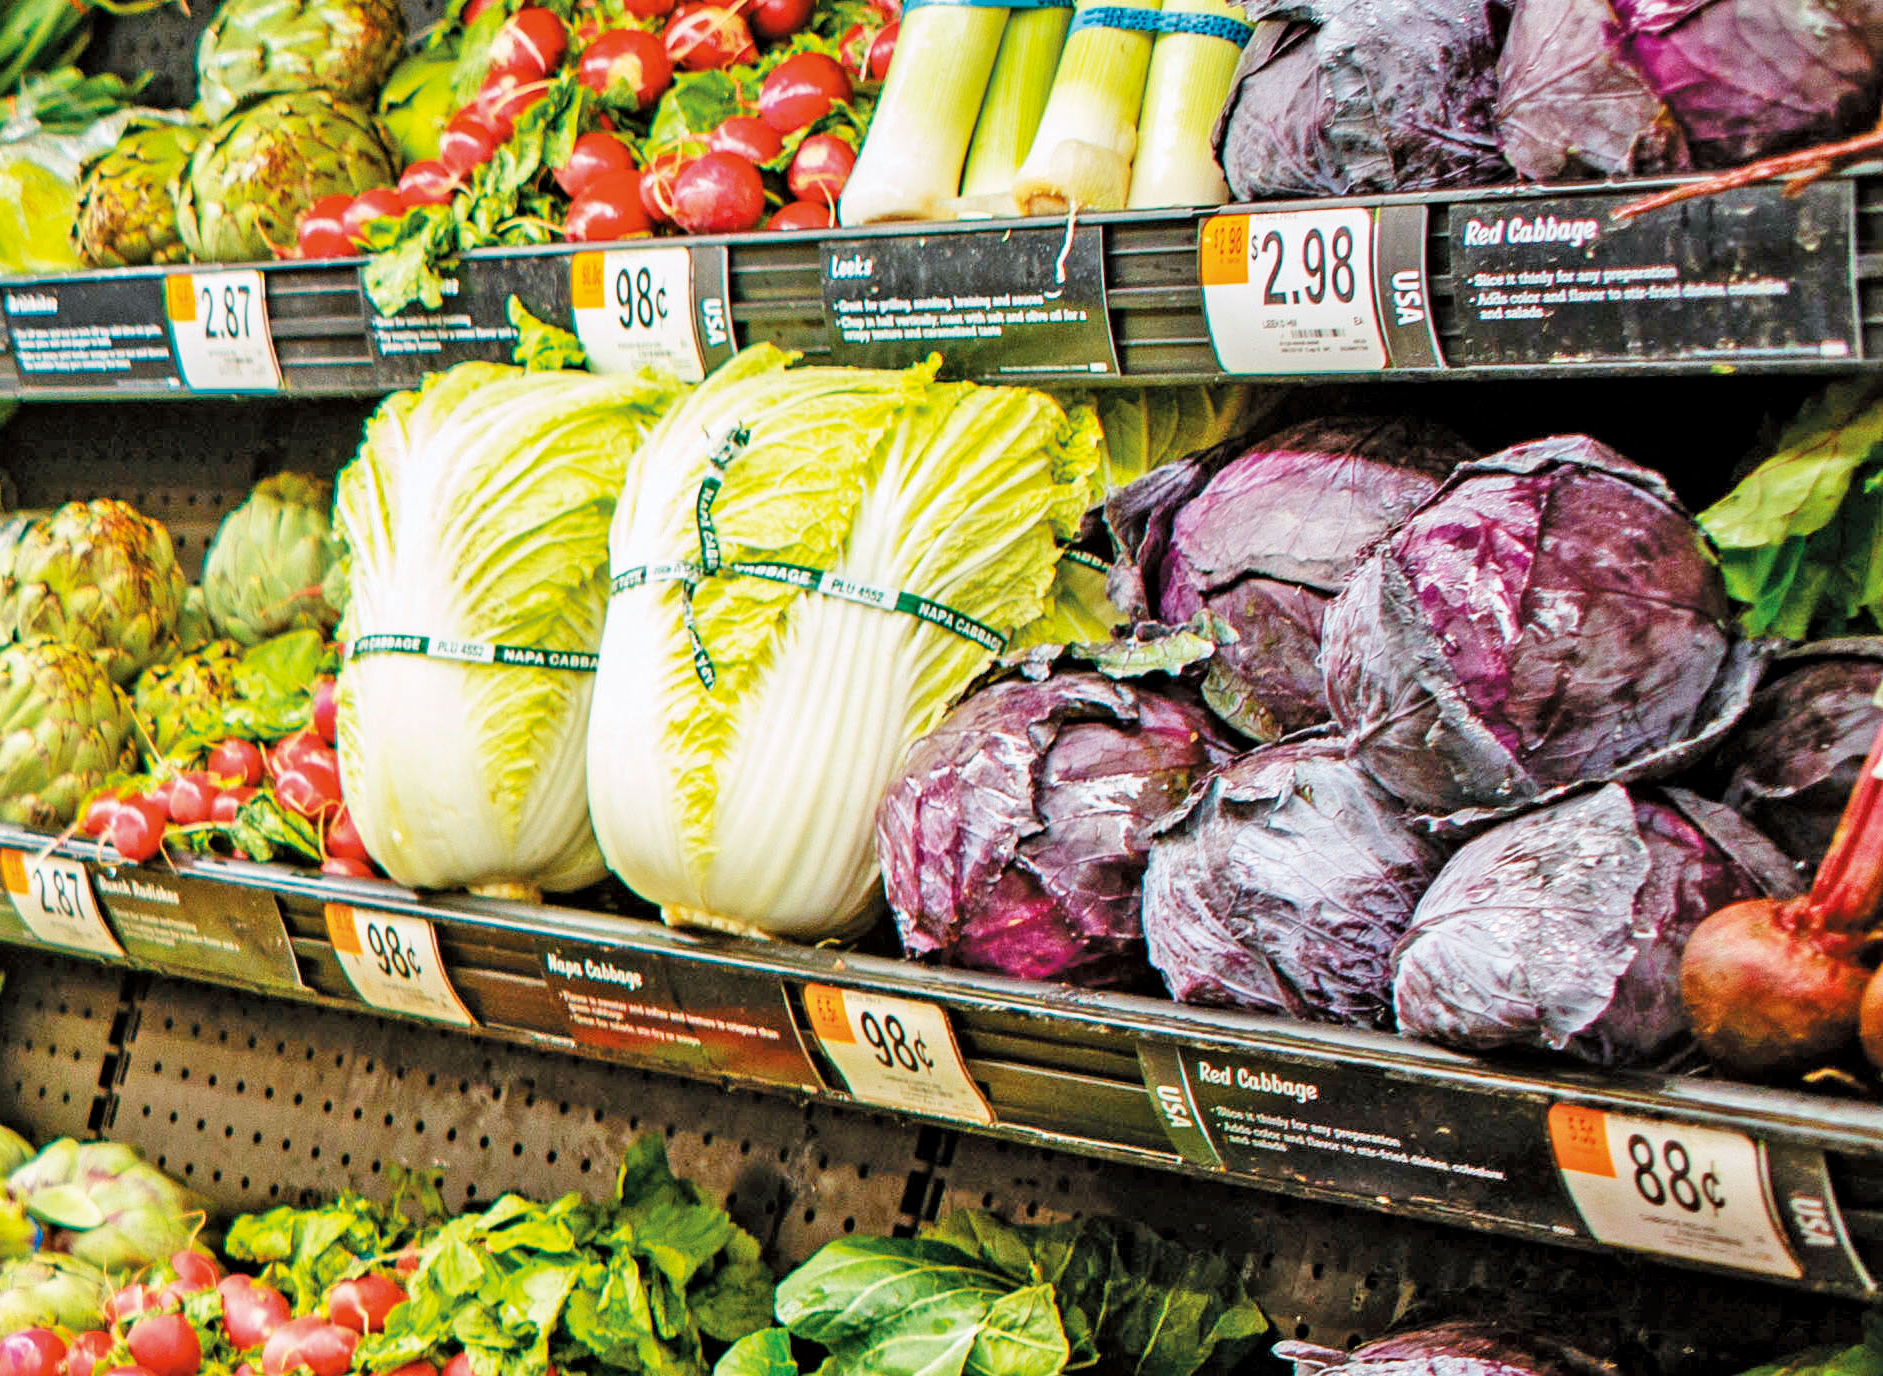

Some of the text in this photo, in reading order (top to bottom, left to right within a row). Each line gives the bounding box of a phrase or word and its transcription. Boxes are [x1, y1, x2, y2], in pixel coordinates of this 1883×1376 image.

[1463, 215, 1599, 248] Red Cabbage
[829, 254, 873, 279] Leeks
[1251, 225, 1356, 306] $2.98
[615, 265, 668, 331] 98¢
[701, 297, 727, 347] USA
[1391, 270, 1425, 327] USA
[830, 579, 885, 603] PLU 4552
[917, 602, 953, 627] NAPA
[503, 648, 544, 665] NAPA
[367, 921, 422, 983] 98¢
[546, 951, 643, 992] Napa Cabbage
[860, 1010, 934, 1077] 98¢
[1197, 1060, 1320, 1104] Red Cabbage
[1155, 1083, 1193, 1130] USA
[1627, 1132, 1726, 1218] 88¢
[1790, 1194, 1838, 1247] USA
